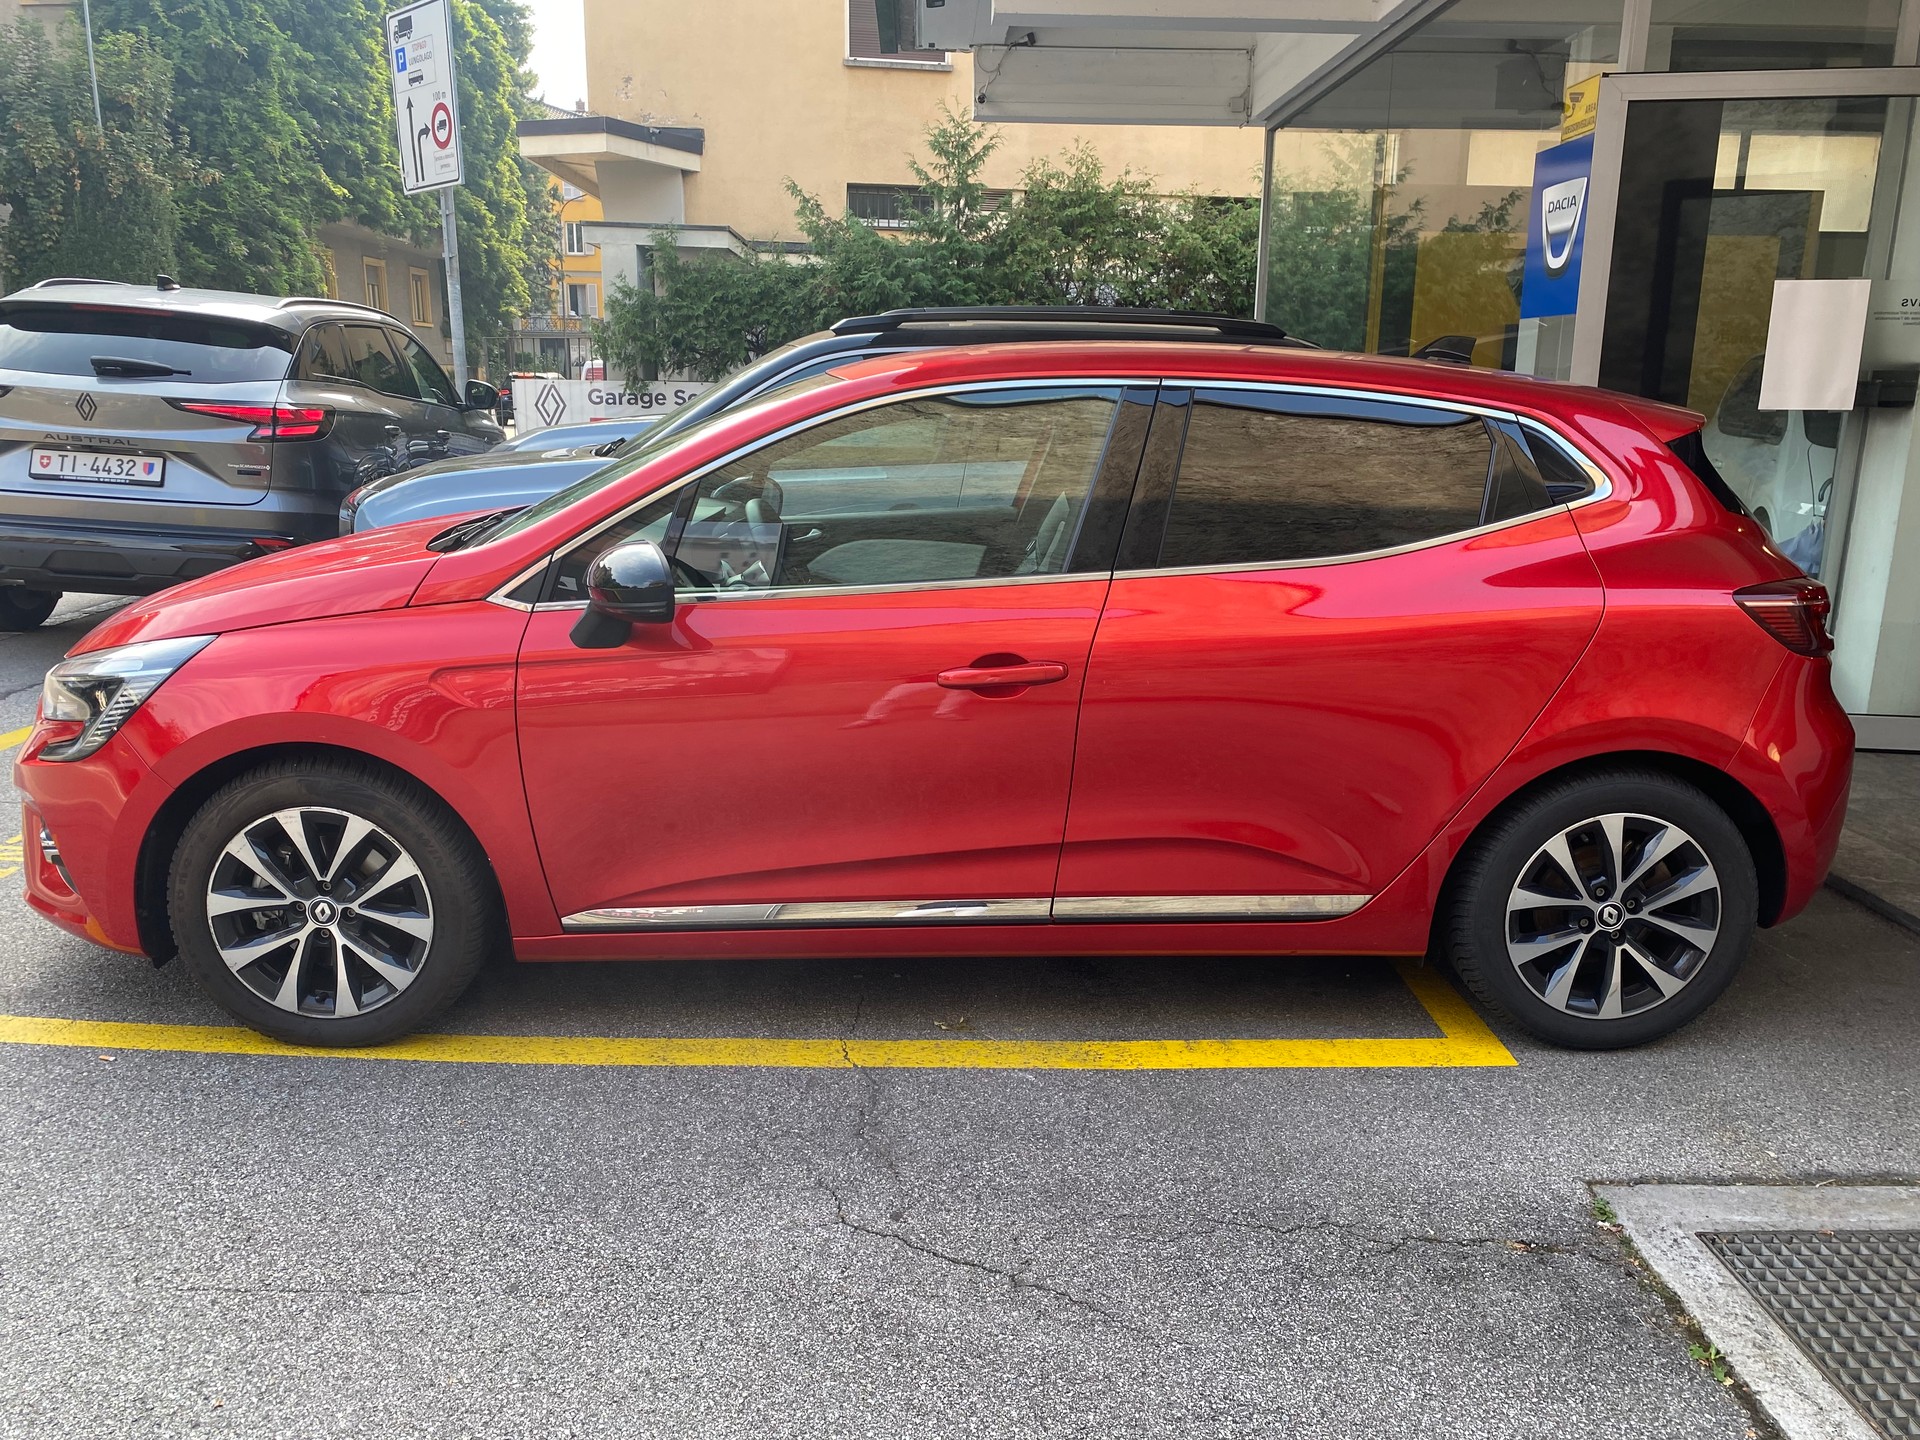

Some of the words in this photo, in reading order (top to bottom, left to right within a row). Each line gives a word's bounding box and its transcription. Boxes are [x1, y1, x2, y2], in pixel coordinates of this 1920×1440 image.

[409, 51, 432, 66] LUNGOLAGO
[432, 90, 441, 101] 100
[1585, 102, 1596, 113] AREA
[1547, 194, 1577, 214] DACIA
[587, 388, 667, 409] Garage
[43, 433, 139, 447] AUSTRAL
